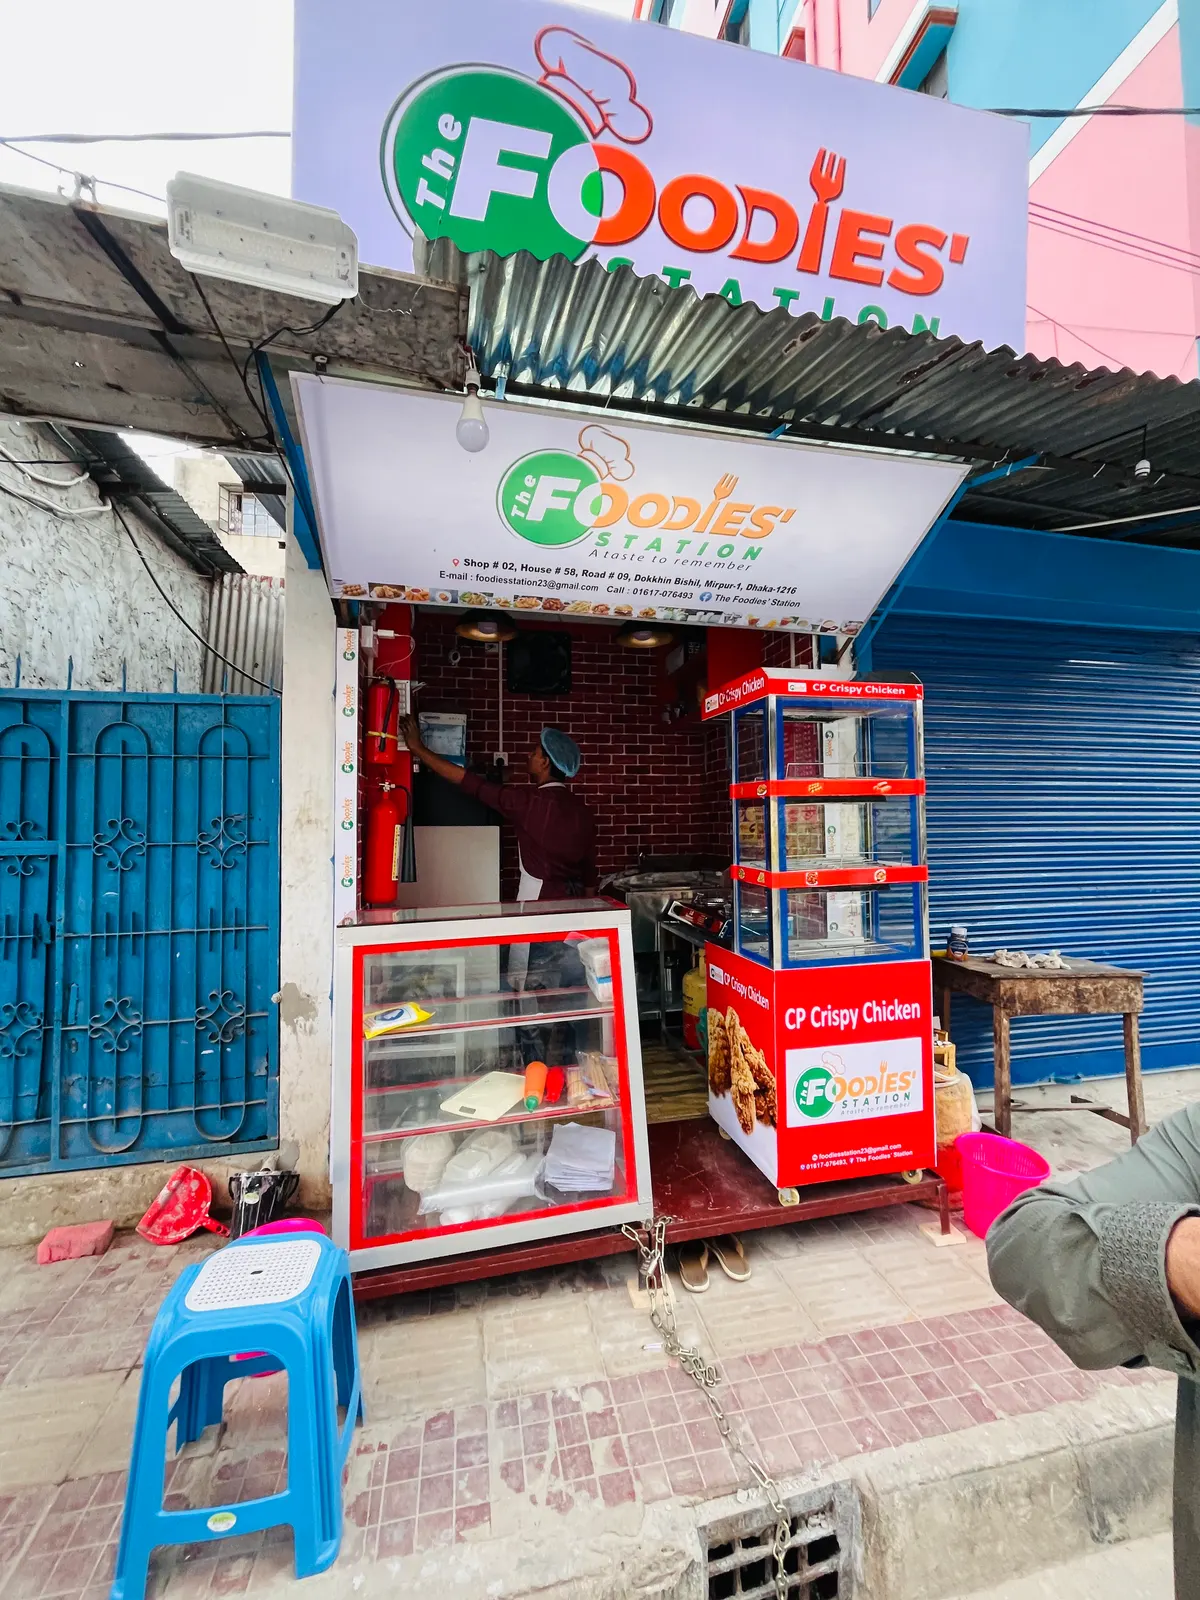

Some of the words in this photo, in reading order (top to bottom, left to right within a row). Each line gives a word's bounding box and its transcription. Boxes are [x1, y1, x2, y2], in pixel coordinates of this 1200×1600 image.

[415, 113, 461, 210] The
[511, 474, 537, 518] The
[589, 548, 598, 558] A
[603, 550, 645, 562] taste
[651, 554, 668, 564] to
[674, 556, 752, 571] remember
[594, 531, 763, 561] STATION
[439, 570, 468, 581] E-mail
[475, 573, 599, 592] foodiesstation23@gmail.com
[606, 585, 625, 595] Call
[632, 587, 694, 600] 01617-076493
[715, 594, 731, 603] The
[771, 598, 801, 608] Station
[464, 558, 490, 571] Shop
[492, 561, 499, 569] #
[502, 562, 517, 572] 02,
[520, 563, 552, 575] House
[564, 568, 579, 578] 58,
[581, 569, 606, 580] Road
[608, 571, 615, 580] #
[617, 572, 631, 583] 09,
[634, 573, 672, 585] Dokkhin
[674, 577, 702, 588] Bishil,
[704, 580, 743, 592] Mirpur-1,
[746, 583, 797, 595] Dhaka-1216
[742, 676, 765, 695] Chicken
[812, 683, 827, 692] CP
[829, 683, 862, 694] Crispy
[865, 685, 906, 695] Chicken
[731, 976, 747, 999] Crispy
[748, 985, 769, 1010] Chicken
[784, 1007, 806, 1030] CP
[810, 1004, 859, 1031] Crispy
[862, 998, 921, 1024] Chicken
[841, 1092, 911, 1109] STATION
[893, 1150, 913, 1158] Station
